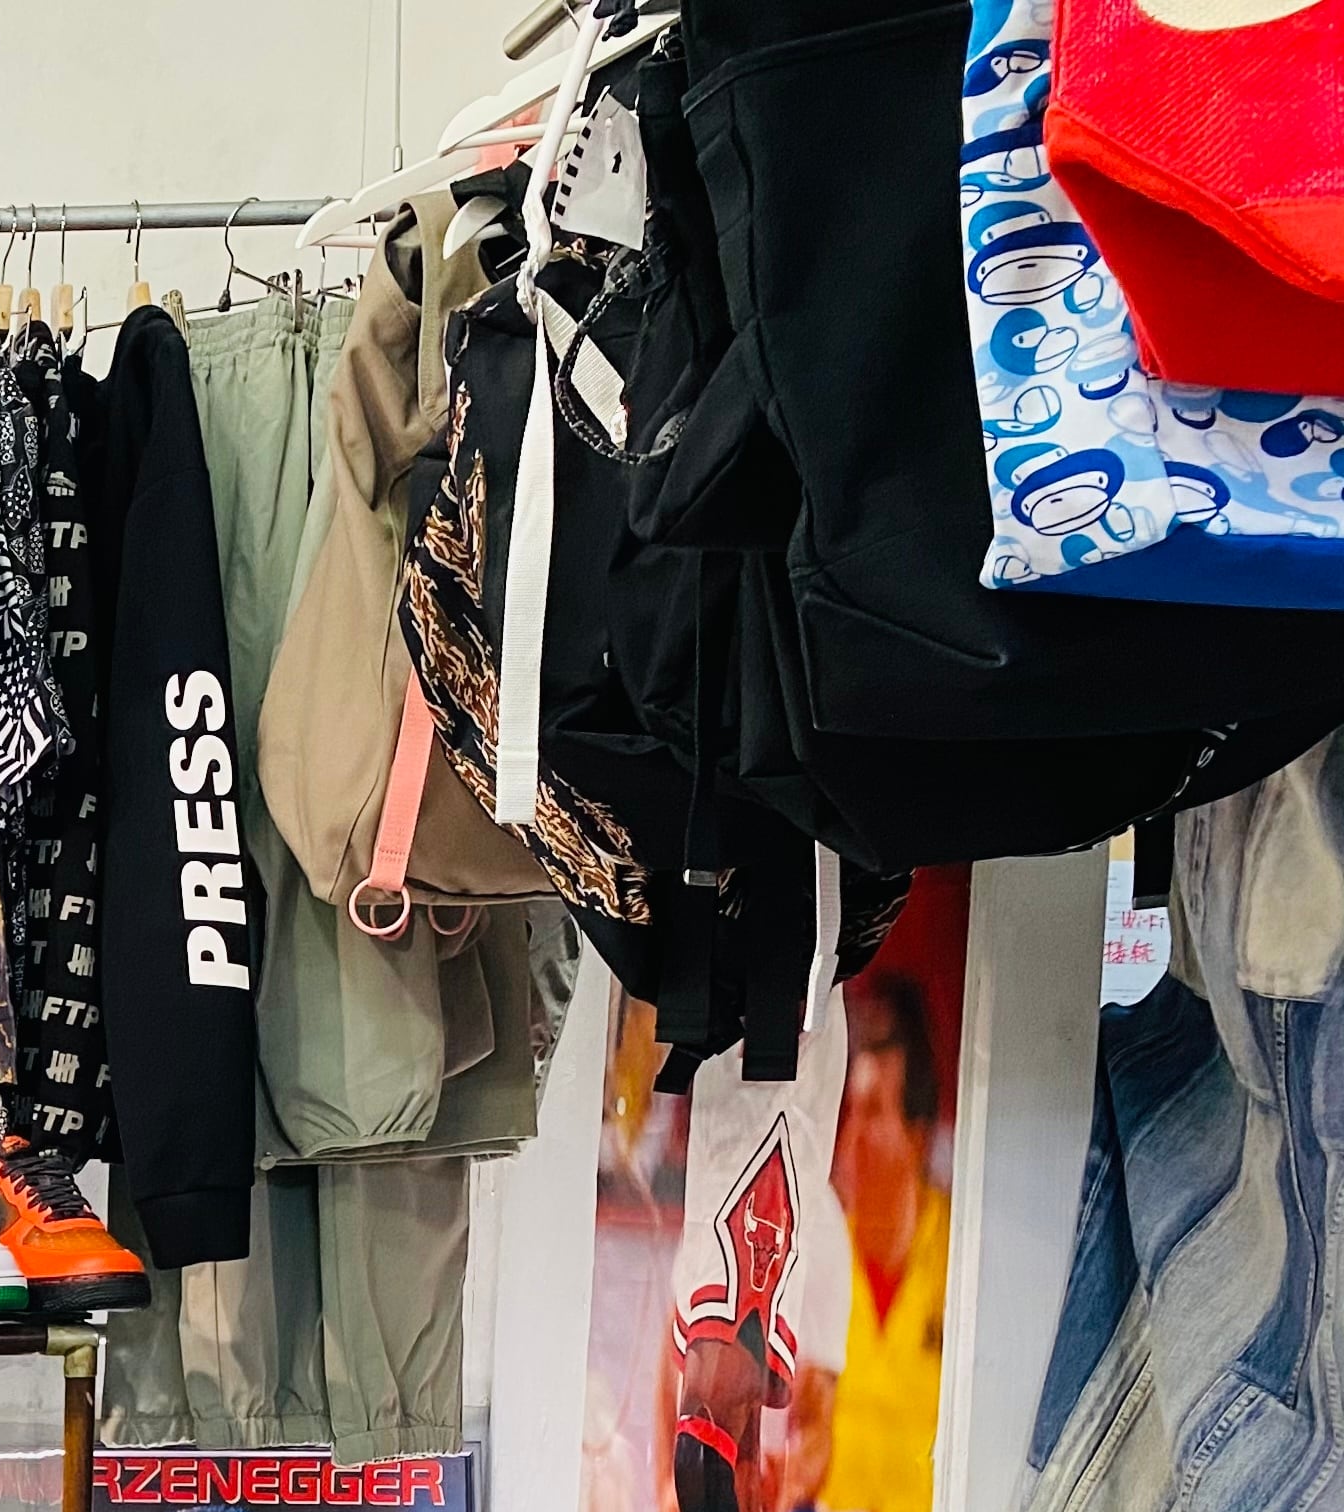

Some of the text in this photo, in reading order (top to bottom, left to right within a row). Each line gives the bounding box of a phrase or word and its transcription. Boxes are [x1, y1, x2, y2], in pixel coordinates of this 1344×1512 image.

[44, 521, 88, 549] TP
[165, 670, 250, 991] PRESS
[41, 996, 100, 1029] FTP
